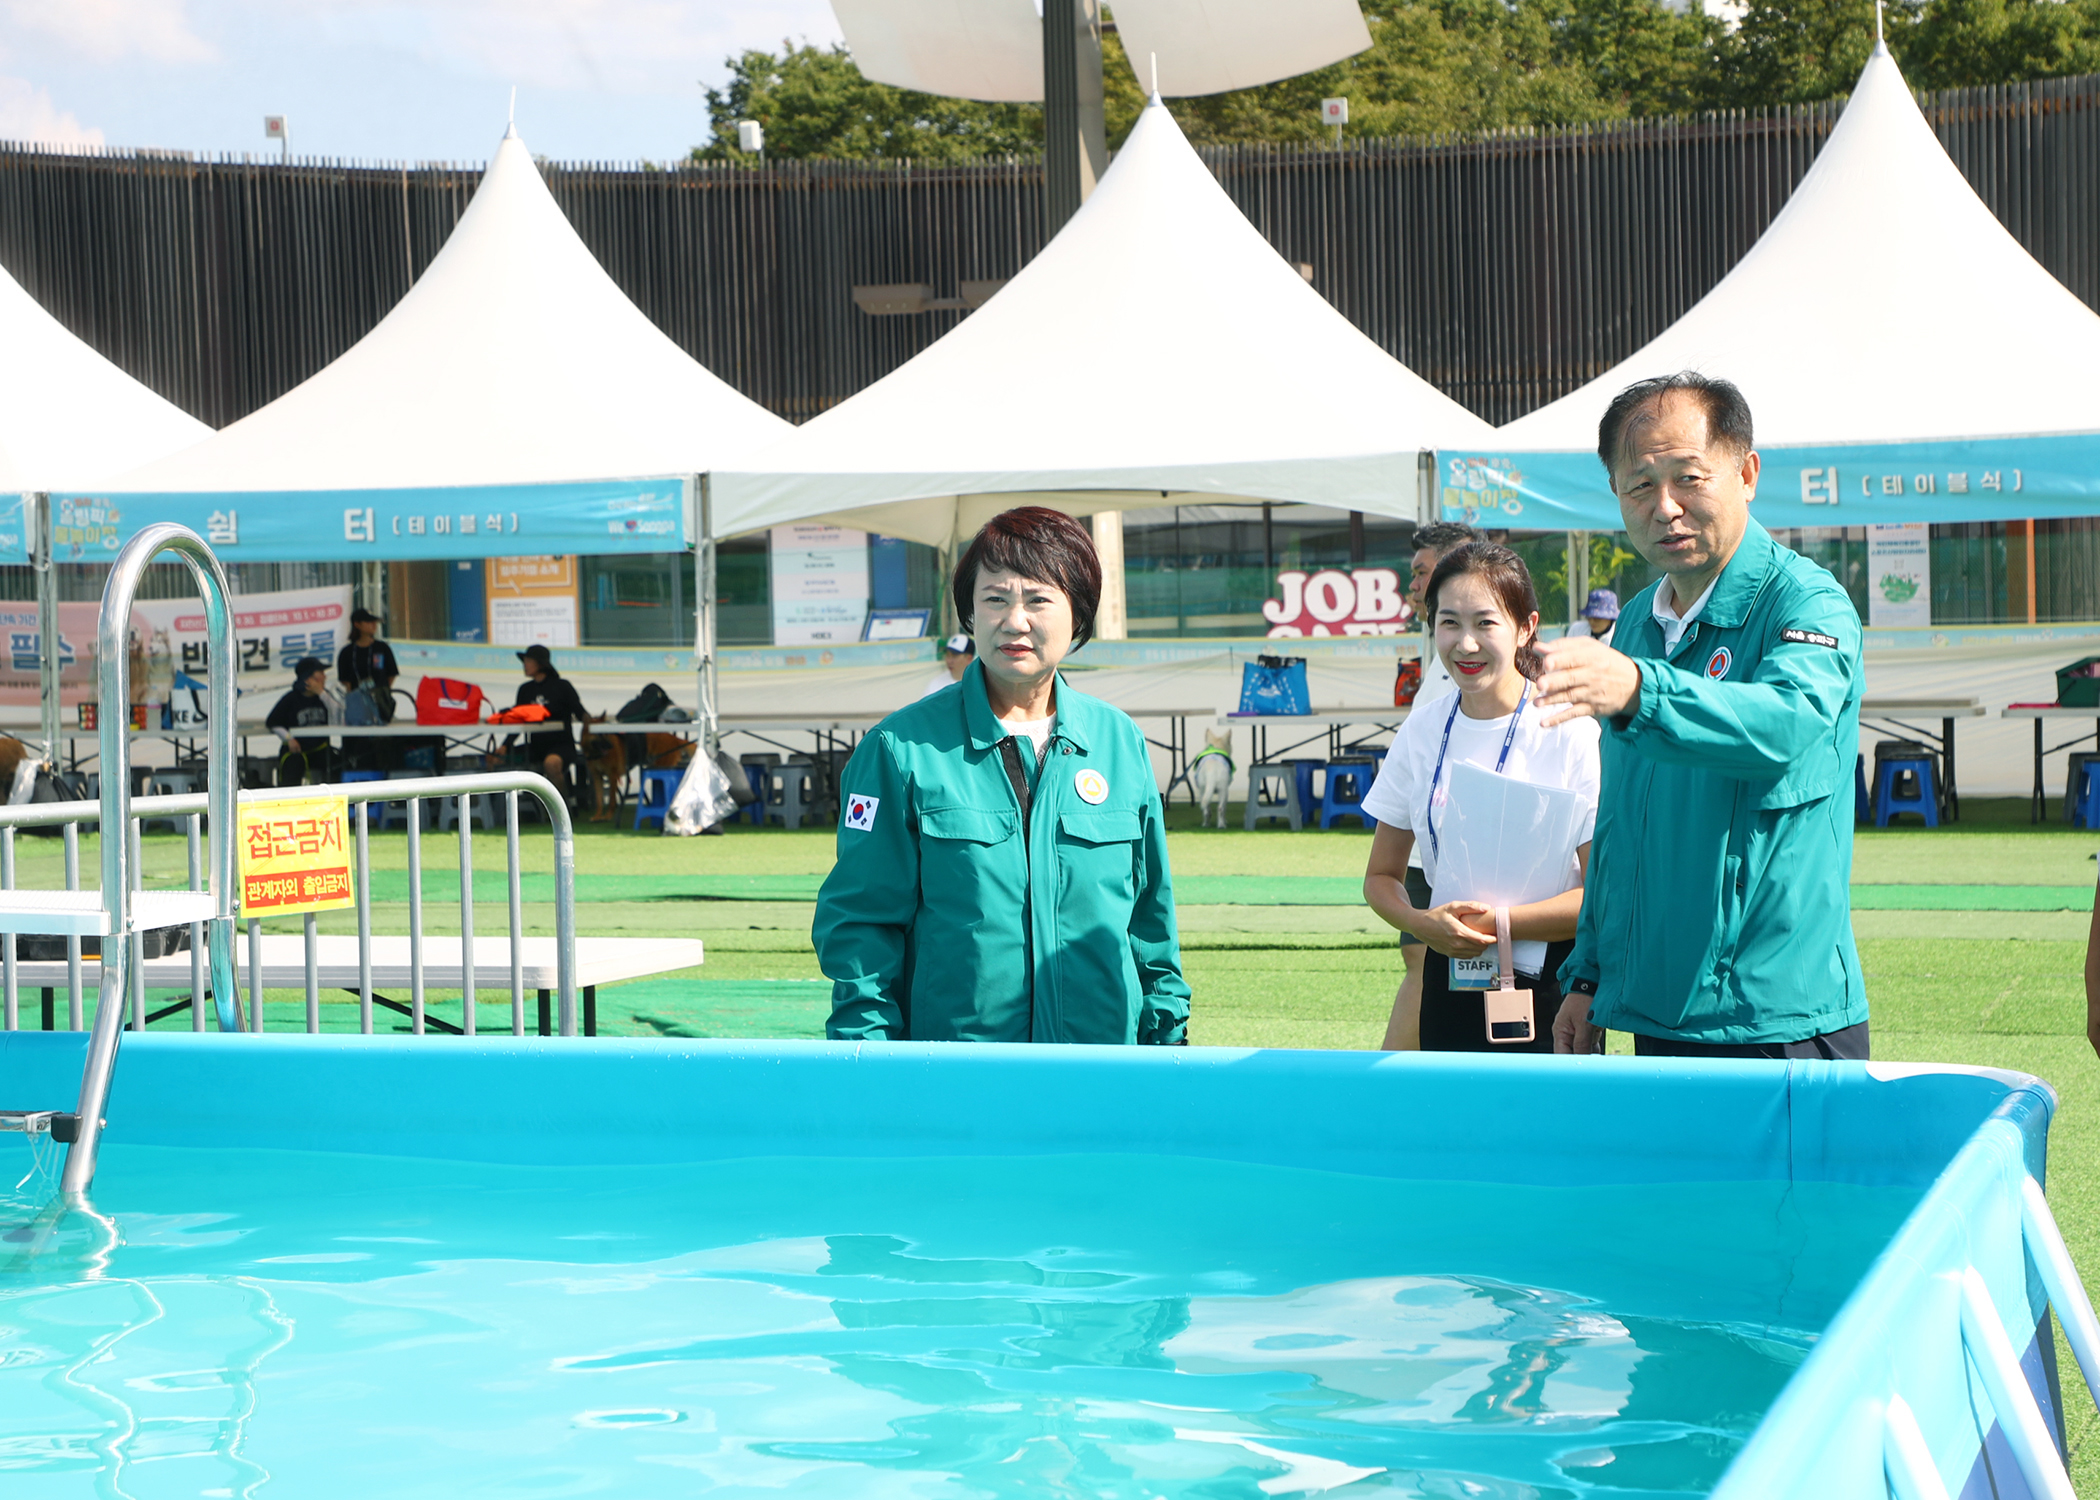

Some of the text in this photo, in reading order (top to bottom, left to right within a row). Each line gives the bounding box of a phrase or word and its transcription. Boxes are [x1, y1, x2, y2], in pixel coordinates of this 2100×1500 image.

[1801, 466, 1838, 505] 터
[1786, 630, 1836, 646] 서울 송파구
[182, 637, 270, 675] 반견
[247, 816, 342, 859] 접근금지
[247, 872, 349, 901] 관계자외 출입금지
[1458, 960, 1493, 971] STAFF
